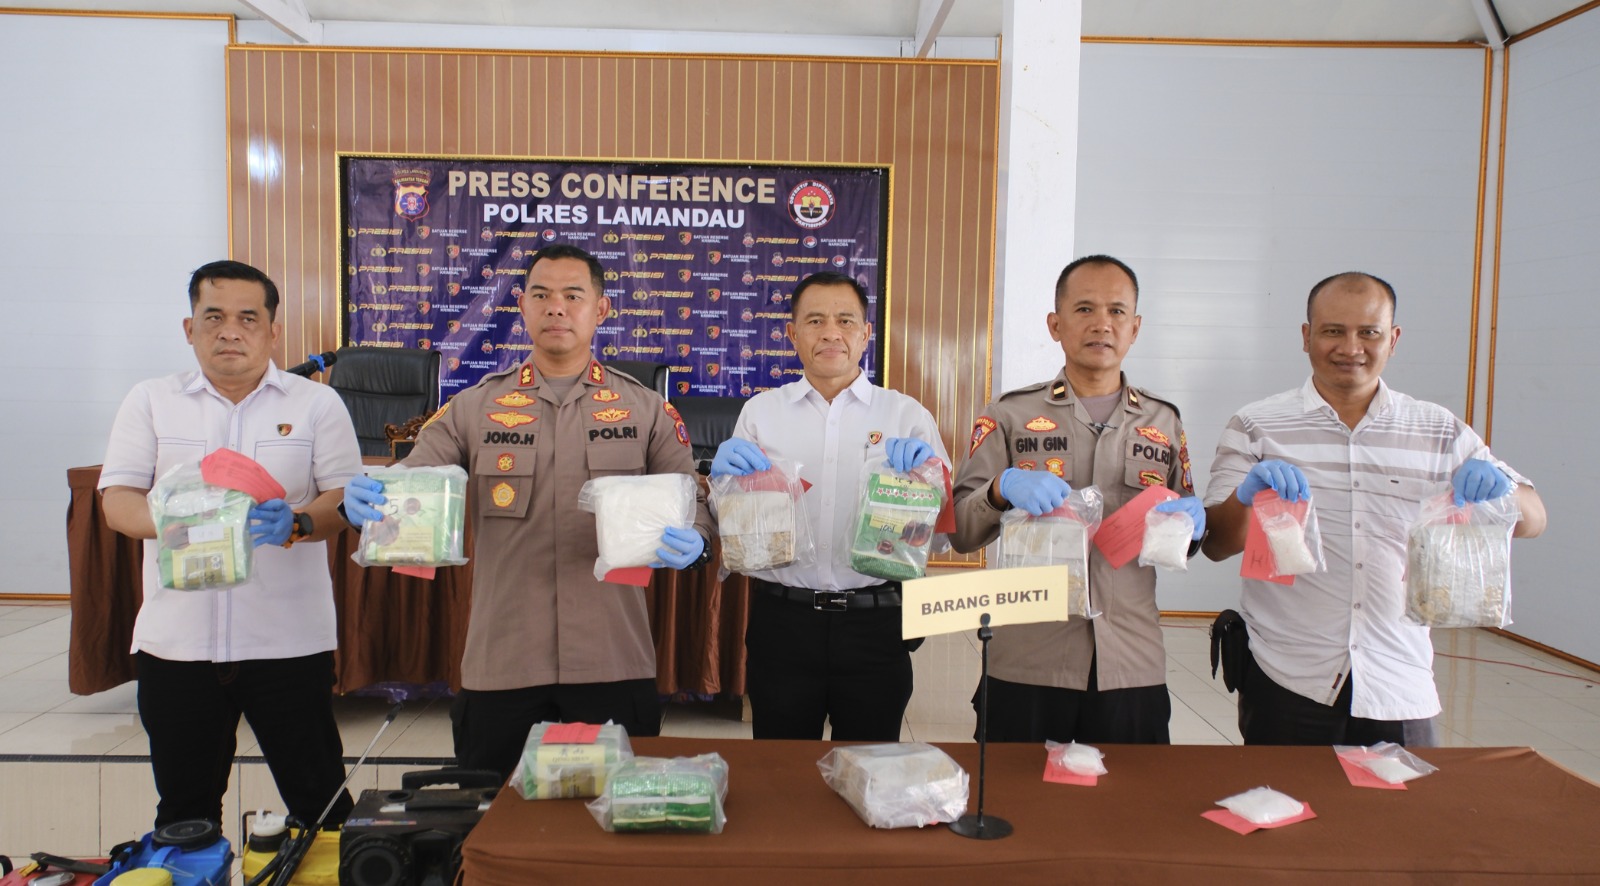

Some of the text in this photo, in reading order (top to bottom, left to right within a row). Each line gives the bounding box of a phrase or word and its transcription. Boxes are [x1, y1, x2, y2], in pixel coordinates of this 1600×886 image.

[448, 171, 775, 204] PRESS CONFERENCE
[484, 203, 744, 229] POLRES LAMANDAU
[483, 431, 535, 445] JOKO.H
[589, 426, 638, 442] POLRI
[1016, 437, 1068, 453] GIN GIN
[1132, 443, 1171, 466] POLRI
[921, 589, 1048, 615] BARANG BUKTI
